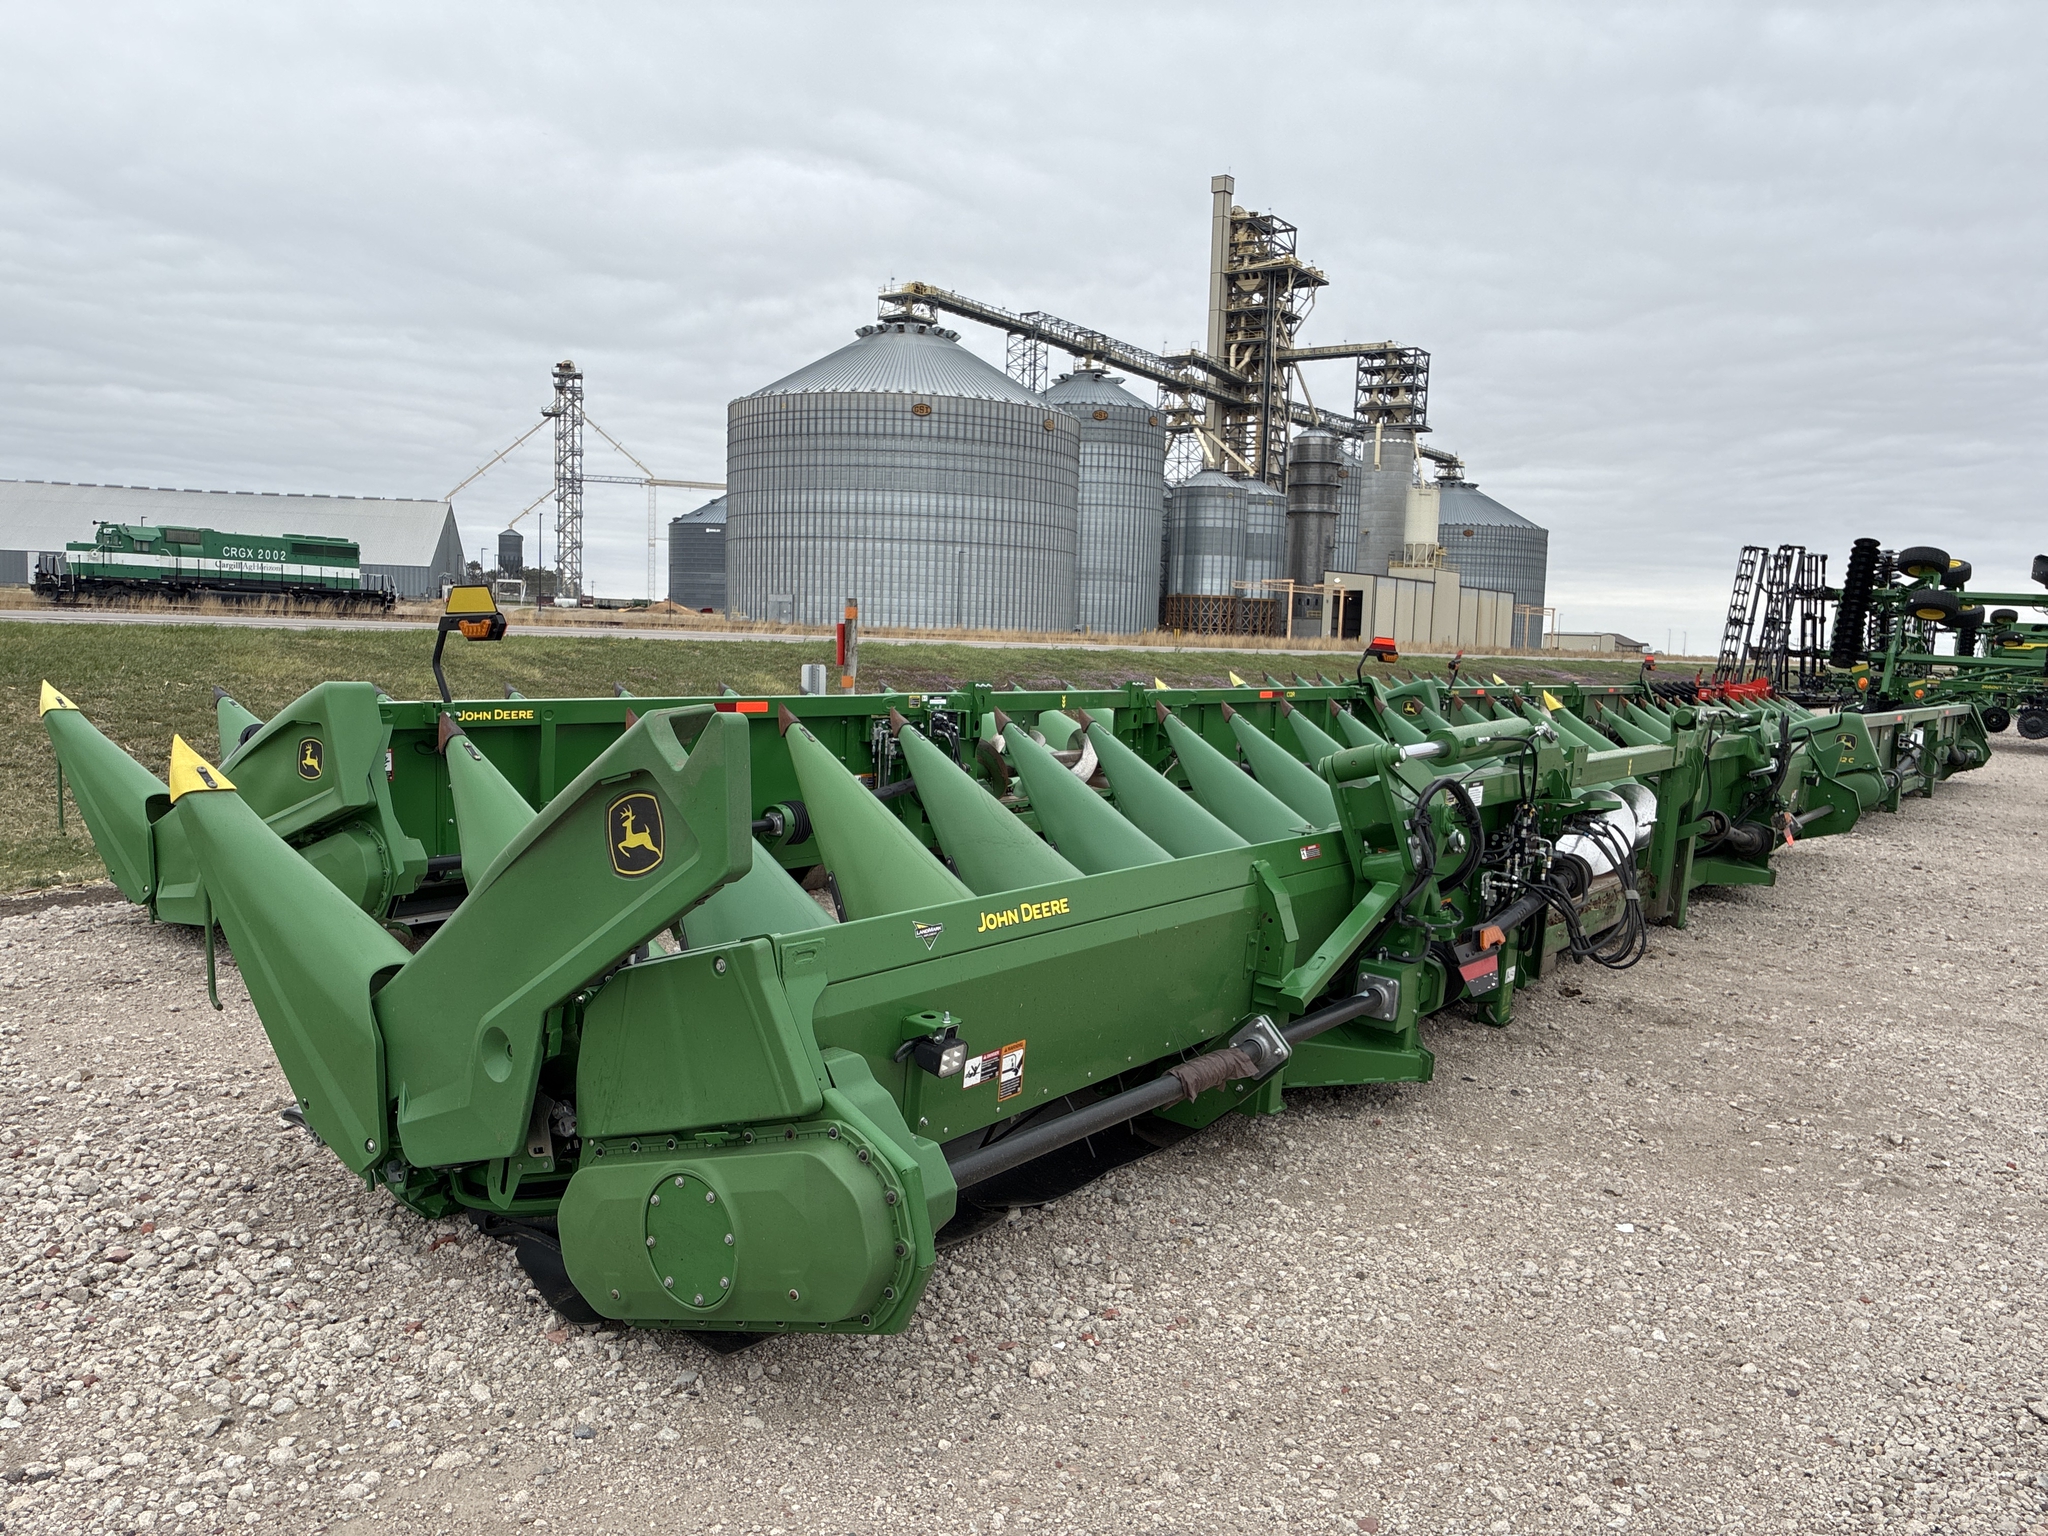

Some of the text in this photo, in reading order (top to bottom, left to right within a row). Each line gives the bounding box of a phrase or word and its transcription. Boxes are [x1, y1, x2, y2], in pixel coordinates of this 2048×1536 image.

[222, 546, 286, 561] CRGX 2002
[214, 560, 283, 572] Cargill AgHorizon
[458, 709, 534, 721] JOHN DEERE
[978, 898, 1070, 933] JOHN DEERE
